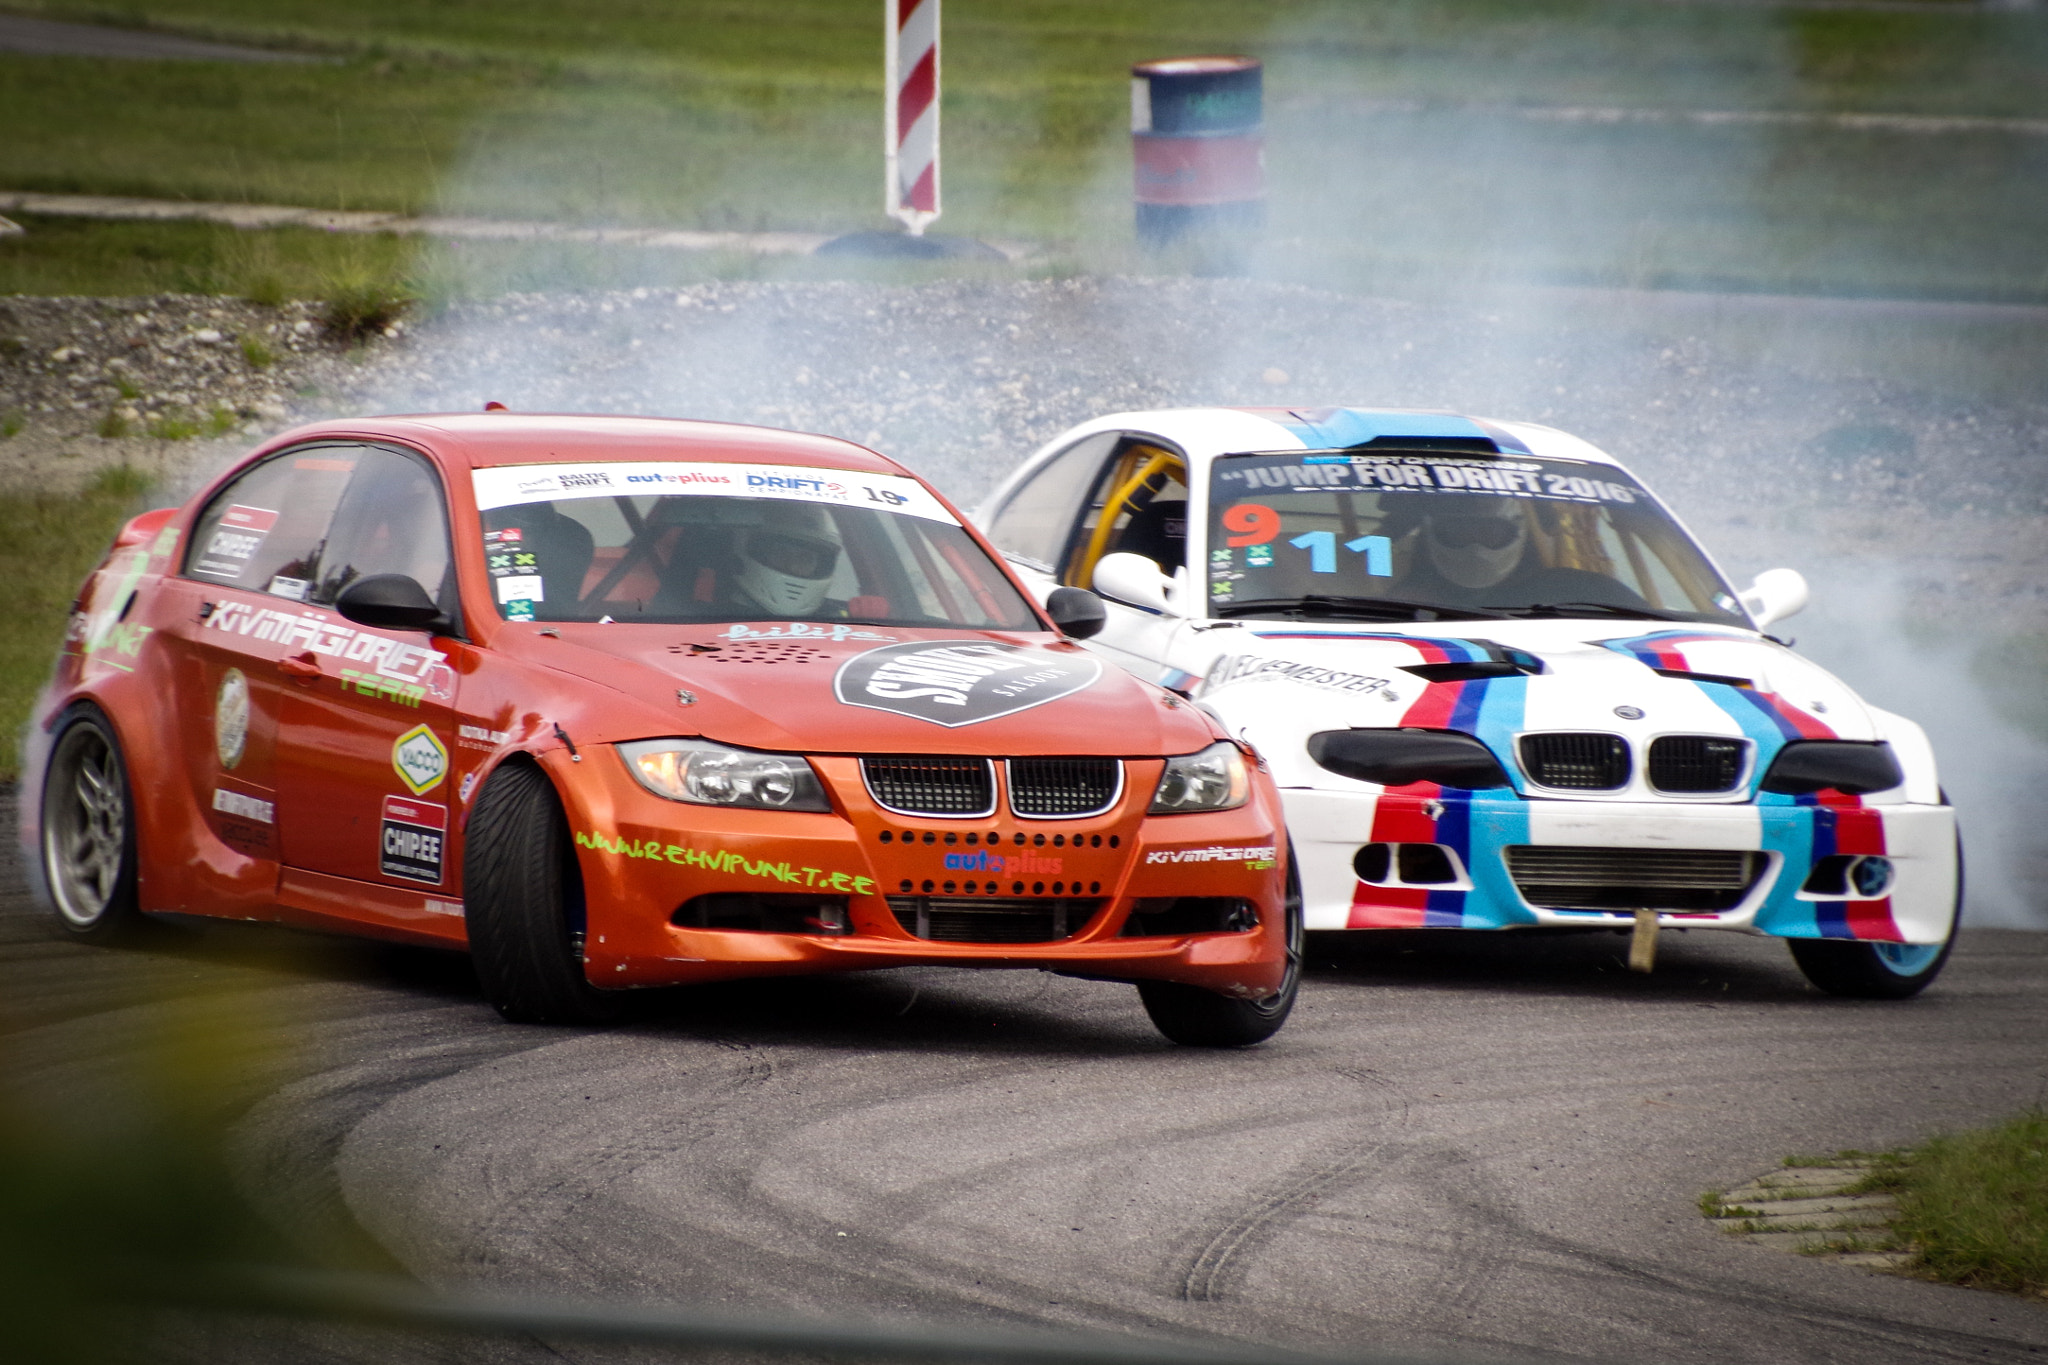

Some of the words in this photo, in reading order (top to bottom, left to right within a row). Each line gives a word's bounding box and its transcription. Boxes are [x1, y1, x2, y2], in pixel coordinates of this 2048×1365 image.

[559, 472, 608, 481] BALTIC
[562, 478, 610, 488] DRIFT
[747, 475, 826, 491] DRIFT
[1354, 463, 1434, 487] FOR
[1434, 464, 1542, 493] DRIFT
[863, 486, 903, 506] 19
[1222, 504, 1281, 548] 9
[1289, 531, 1393, 577] 11
[340, 669, 427, 708] TEAM
[866, 644, 1056, 706] SMOKY
[993, 667, 1072, 698] SALOON
[401, 748, 443, 772] YACCO
[383, 827, 441, 863] CHIP.EE
[944, 850, 1063, 878] autoplius
